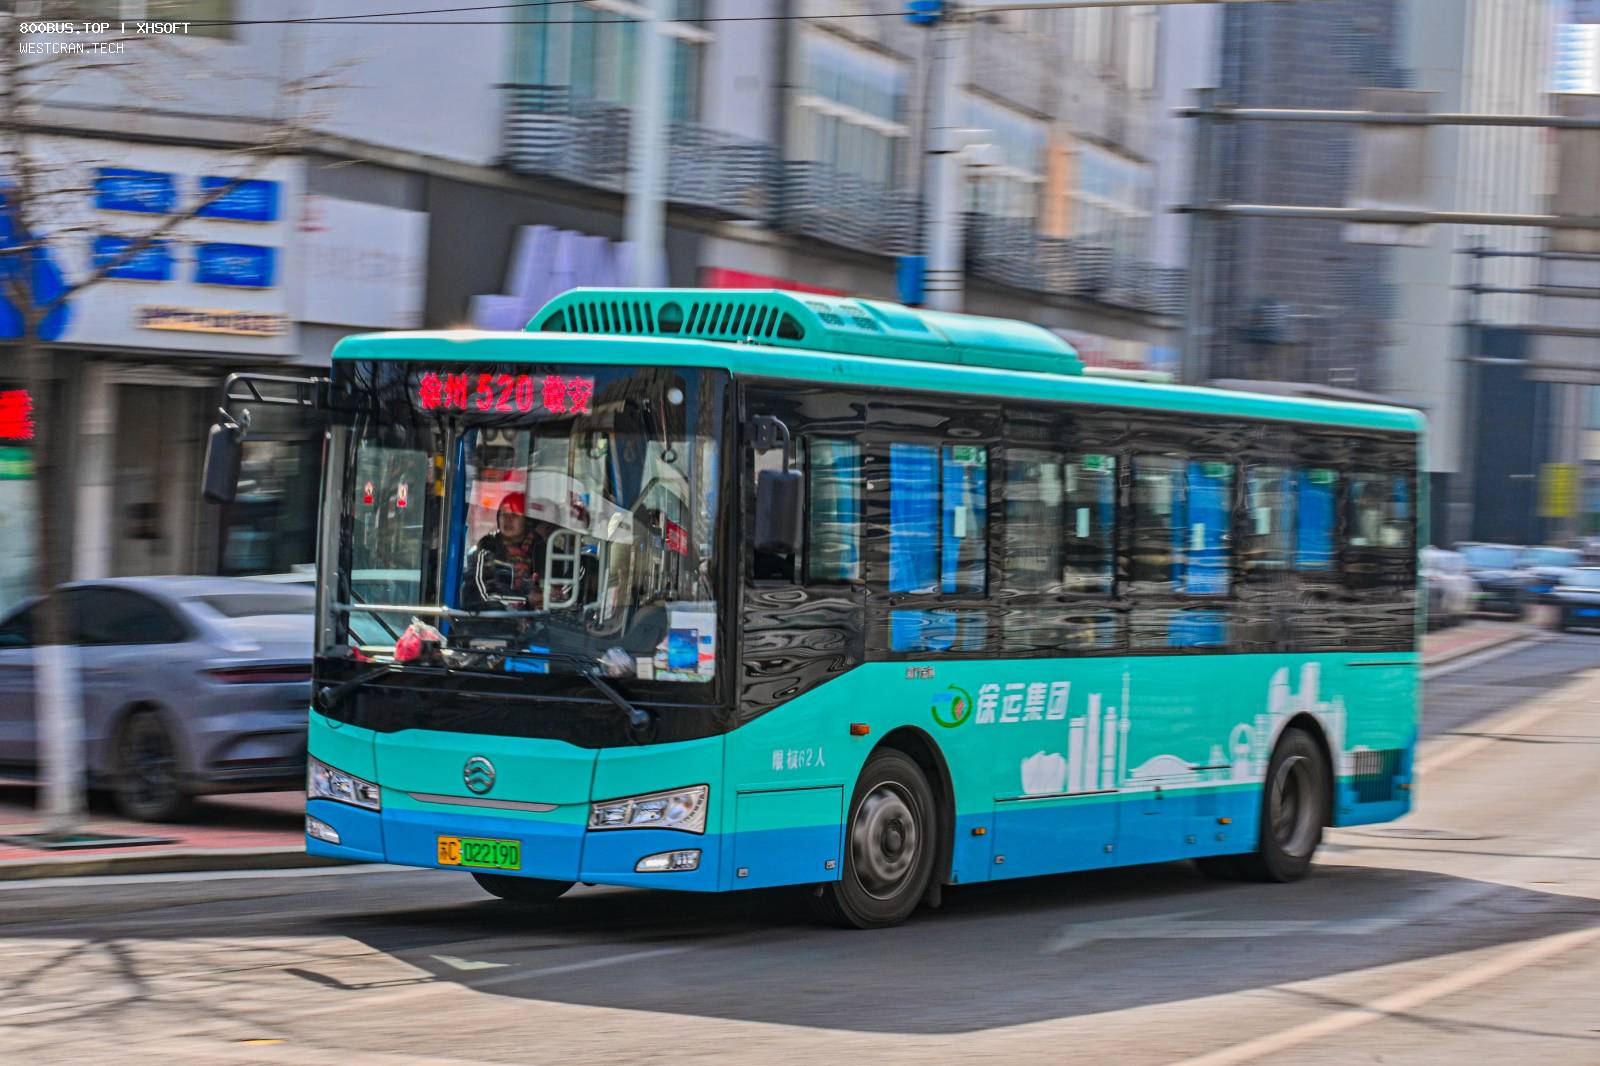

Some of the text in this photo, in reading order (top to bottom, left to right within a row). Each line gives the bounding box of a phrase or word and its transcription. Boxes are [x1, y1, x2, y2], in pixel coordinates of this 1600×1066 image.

[475, 373, 534, 412] 520
[975, 681, 1072, 724] 徐运集团
